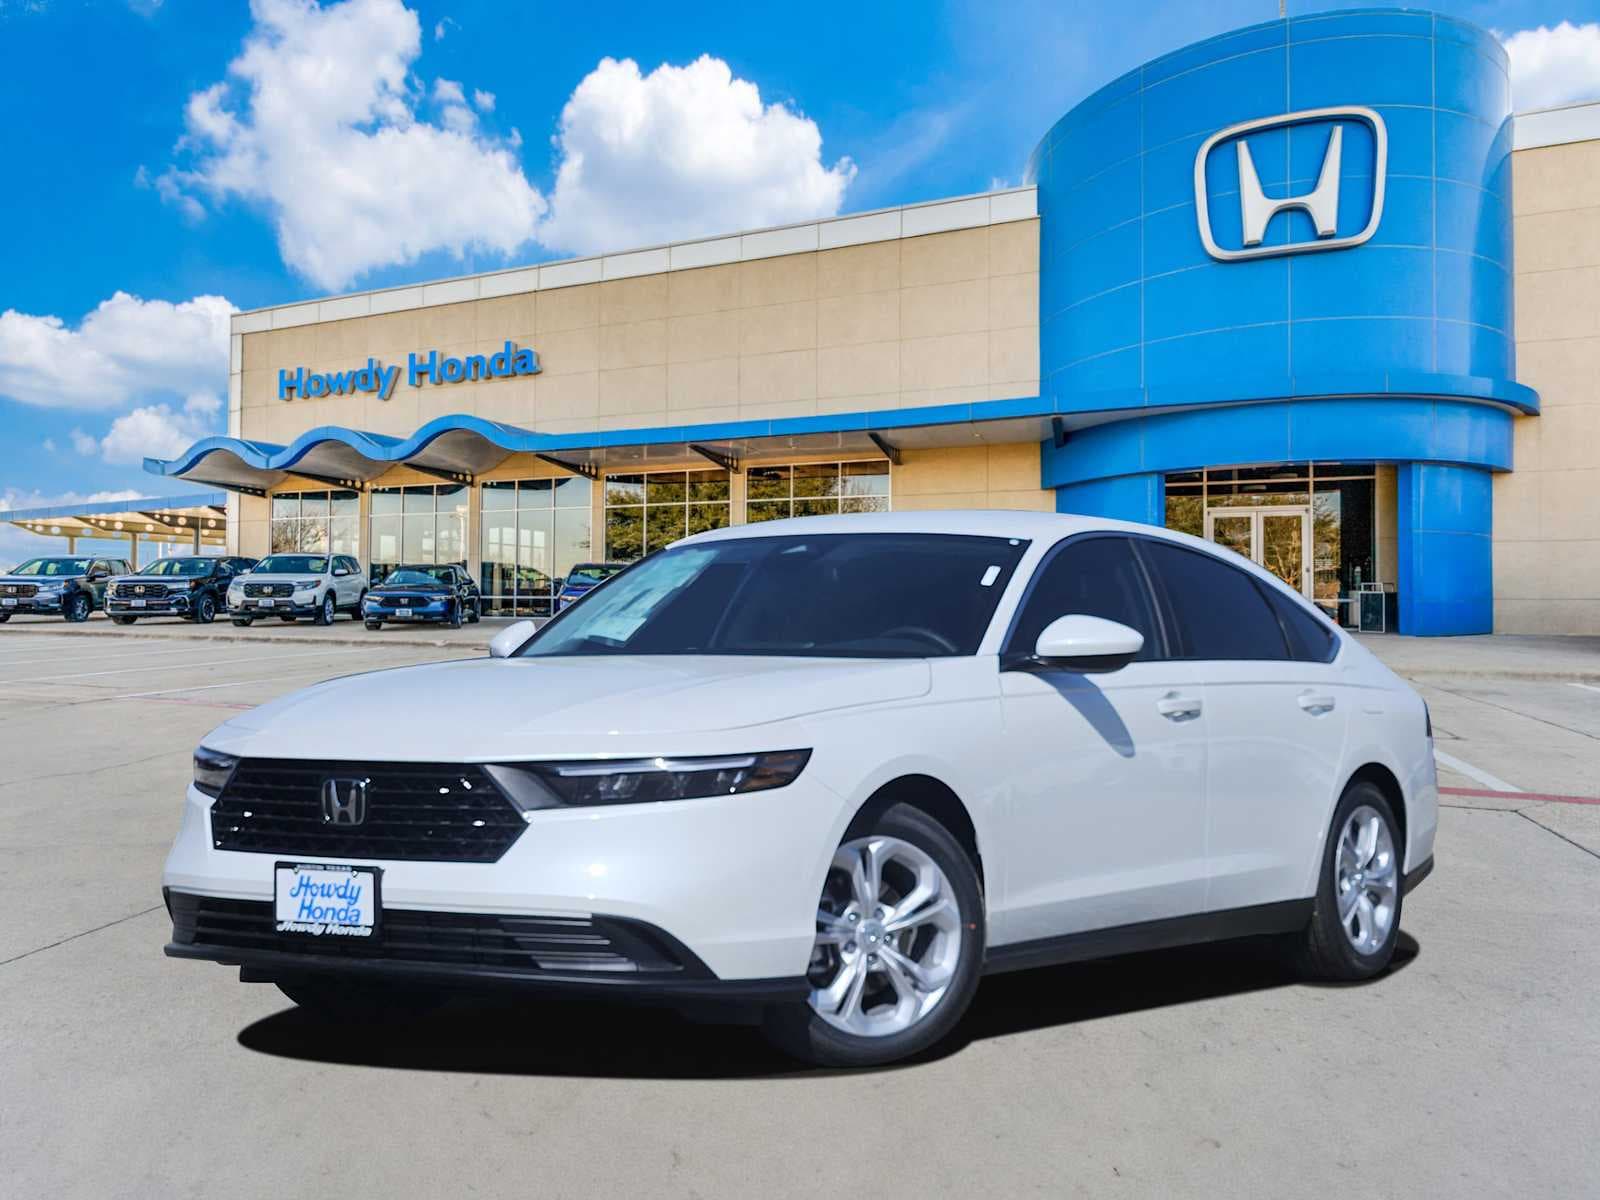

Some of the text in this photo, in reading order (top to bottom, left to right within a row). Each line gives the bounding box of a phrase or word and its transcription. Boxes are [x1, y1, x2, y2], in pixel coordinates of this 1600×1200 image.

[278, 340, 541, 401] Howdy Honda
[290, 876, 361, 905] Howdy
[299, 899, 361, 922] Honda
